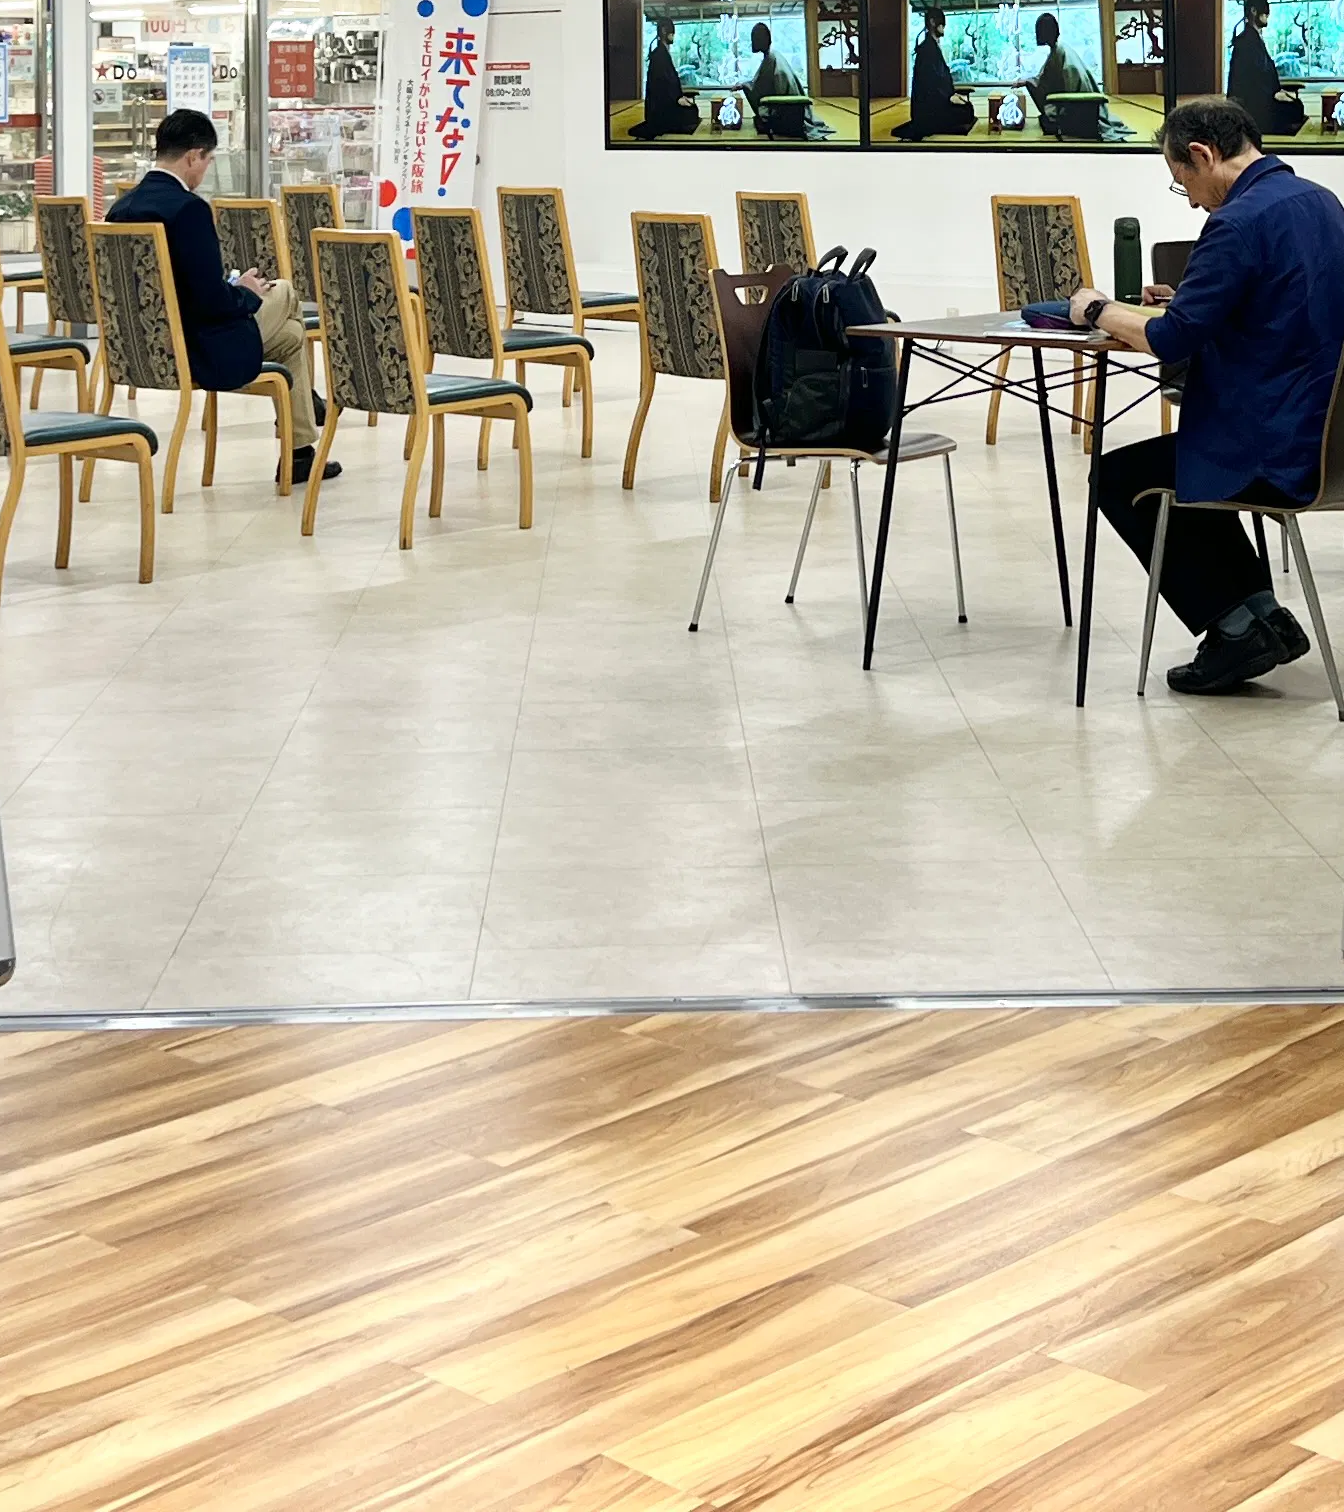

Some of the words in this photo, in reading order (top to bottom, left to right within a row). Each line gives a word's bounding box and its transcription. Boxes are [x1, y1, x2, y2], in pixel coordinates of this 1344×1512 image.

[410, 25, 436, 194] オモロイがいっぱい大阪旅
